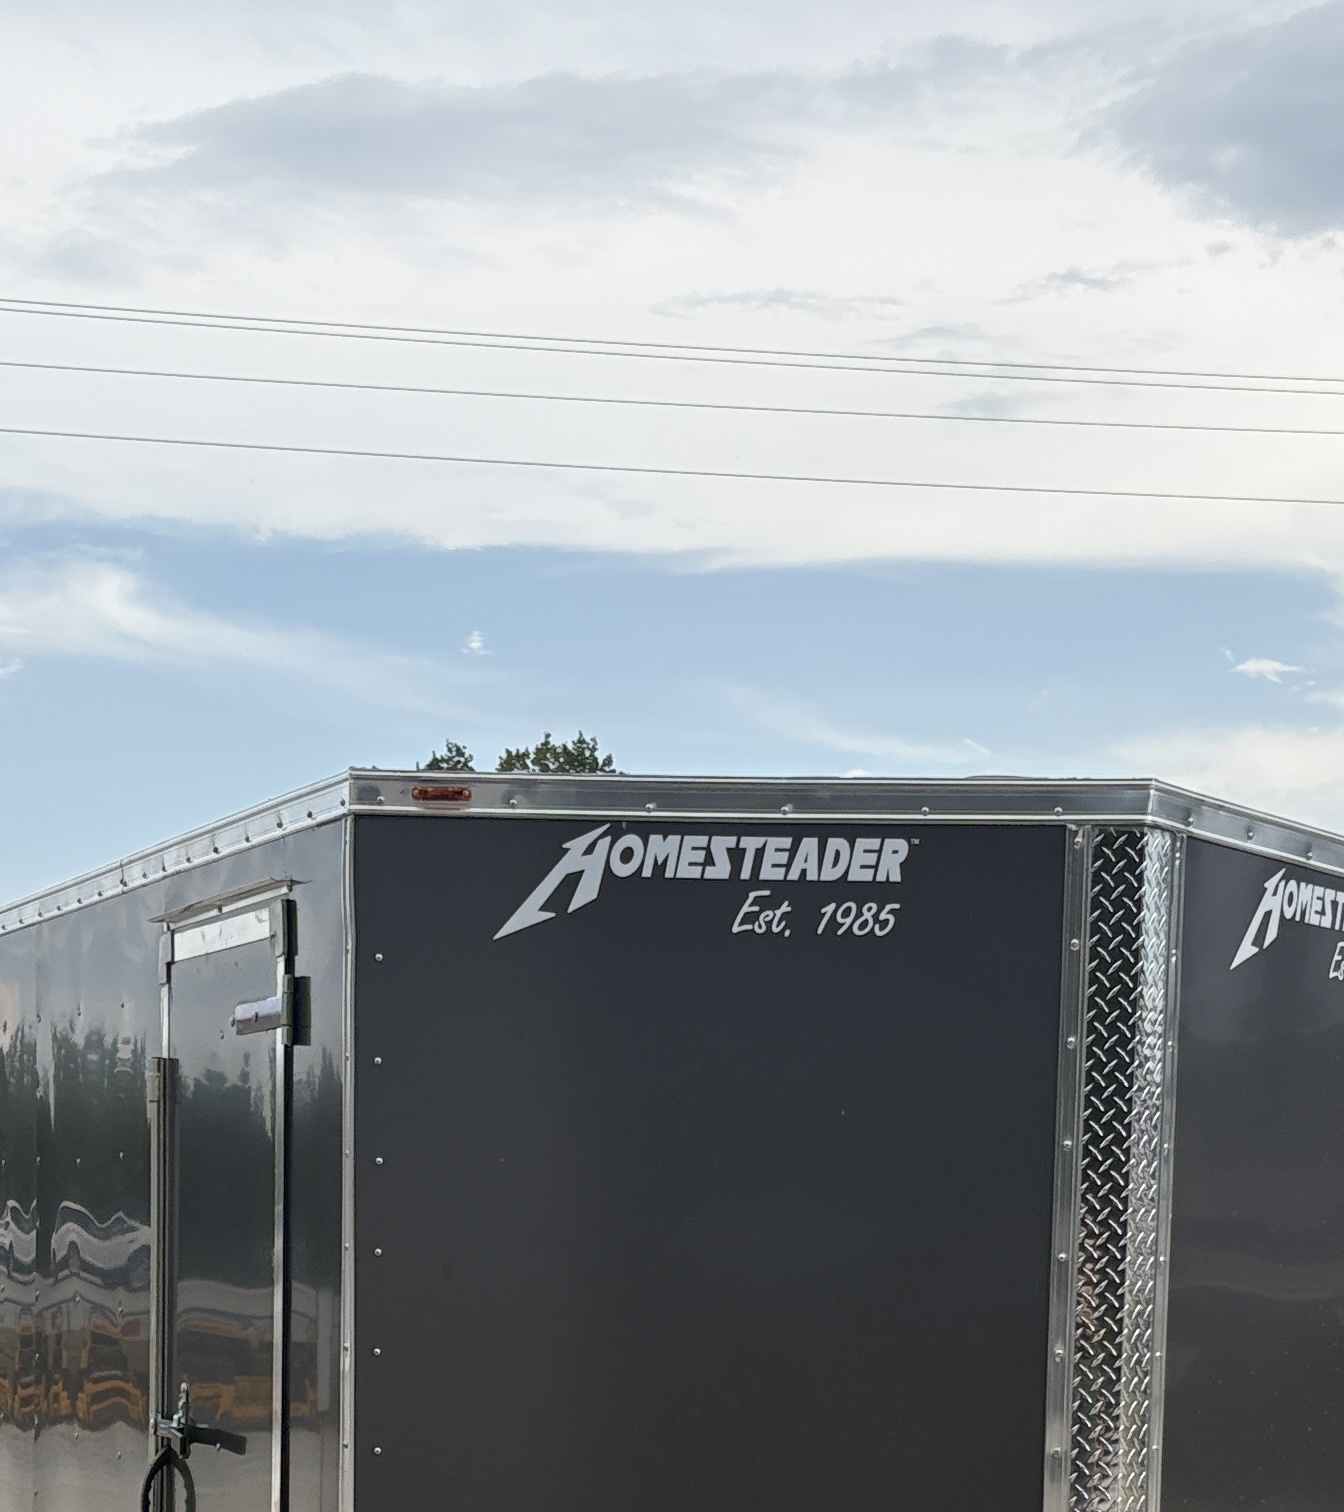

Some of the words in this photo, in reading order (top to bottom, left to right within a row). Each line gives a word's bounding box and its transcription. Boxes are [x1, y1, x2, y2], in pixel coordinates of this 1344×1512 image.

[493, 823, 910, 940] HOMESTEADER
[731, 889, 792, 938] Est.
[816, 901, 901, 937] 1985
